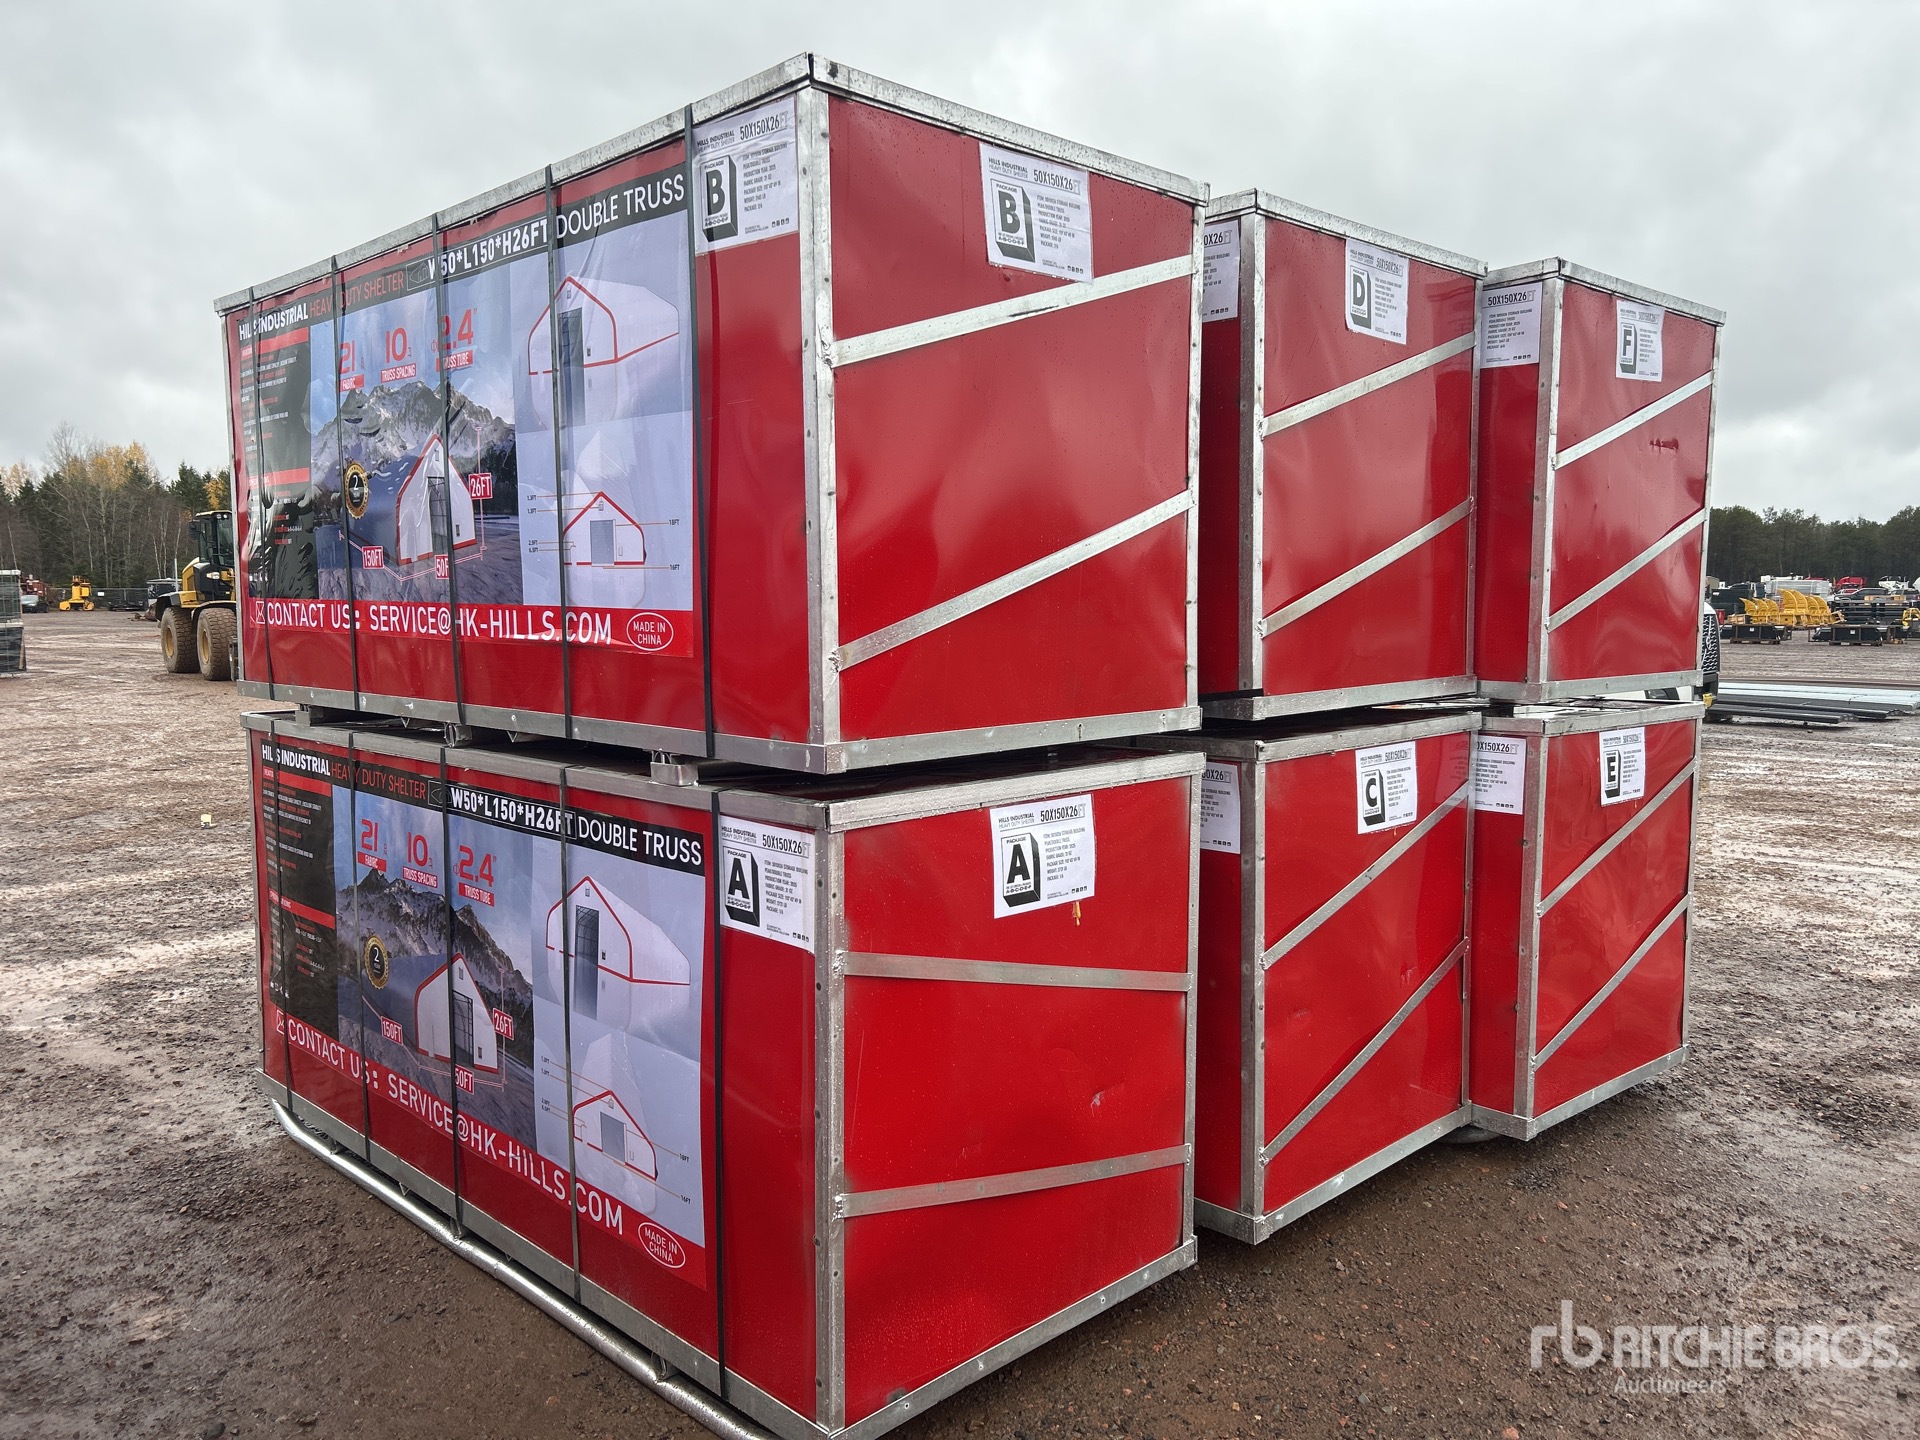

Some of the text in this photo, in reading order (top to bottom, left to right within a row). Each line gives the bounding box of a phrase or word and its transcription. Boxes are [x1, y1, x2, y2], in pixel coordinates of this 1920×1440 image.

[710, 130, 734, 142] INDUSTRIAL
[988, 157, 1000, 165] HILLS
[1001, 161, 1027, 172] INDUSTRIAL
[706, 167, 726, 215] B
[995, 183, 1017, 193] PACKAGE
[998, 190, 1021, 235] B
[239, 319, 260, 340] HILS
[258, 303, 308, 334] INDUSTRIAL
[309, 295, 333, 318] HEAV
[340, 285, 362, 308] DUTY
[364, 271, 404, 300] SHELTER
[556, 194, 619, 239] DOUBLE
[623, 173, 685, 216] TRUSS
[1352, 273, 1365, 307] D
[385, 327, 408, 364] 10
[1622, 328, 1631, 356] F
[457, 351, 469, 368] TUBE
[381, 365, 416, 382] TRUSS SPACING
[353, 475, 359, 490] 2
[470, 476, 492, 497] 26FT
[364, 548, 383, 568] 150FT
[437, 558, 449, 577] 50F
[267, 602, 326, 627] CONTACT
[633, 621, 666, 633] MADE IN
[637, 634, 662, 645] CHINA
[1606, 755, 1616, 782] E
[1365, 777, 1377, 808] C
[262, 744, 280, 764] HILS
[281, 749, 331, 776] INDUSTRIAL
[362, 769, 386, 789] DUTY
[388, 775, 426, 800] SHELTER
[578, 816, 638, 852] DOUBLE
[642, 830, 702, 866] TRUSS
[1010, 812, 1034, 821] INDUSTRIAL
[361, 818, 378, 852] 21
[732, 828, 756, 838] INDUSTRIAL
[407, 831, 428, 867] 10
[727, 849, 746, 858] PACKAGE
[1005, 842, 1030, 884] A
[403, 867, 438, 888] TRUSS SPACING
[727, 855, 749, 900] A
[464, 884, 491, 905] TRUSS TUBE
[374, 946, 380, 962] 2
[382, 1020, 402, 1043] 150FT
[494, 1012, 513, 1037] 26FT
[455, 1067, 473, 1092] 50FT
[288, 1019, 346, 1070] CONTACT
[388, 1073, 623, 1236] SERVICE@HK-HILLS.COM
[644, 1227, 678, 1255] MADE IN
[649, 1243, 673, 1265] CHINA
